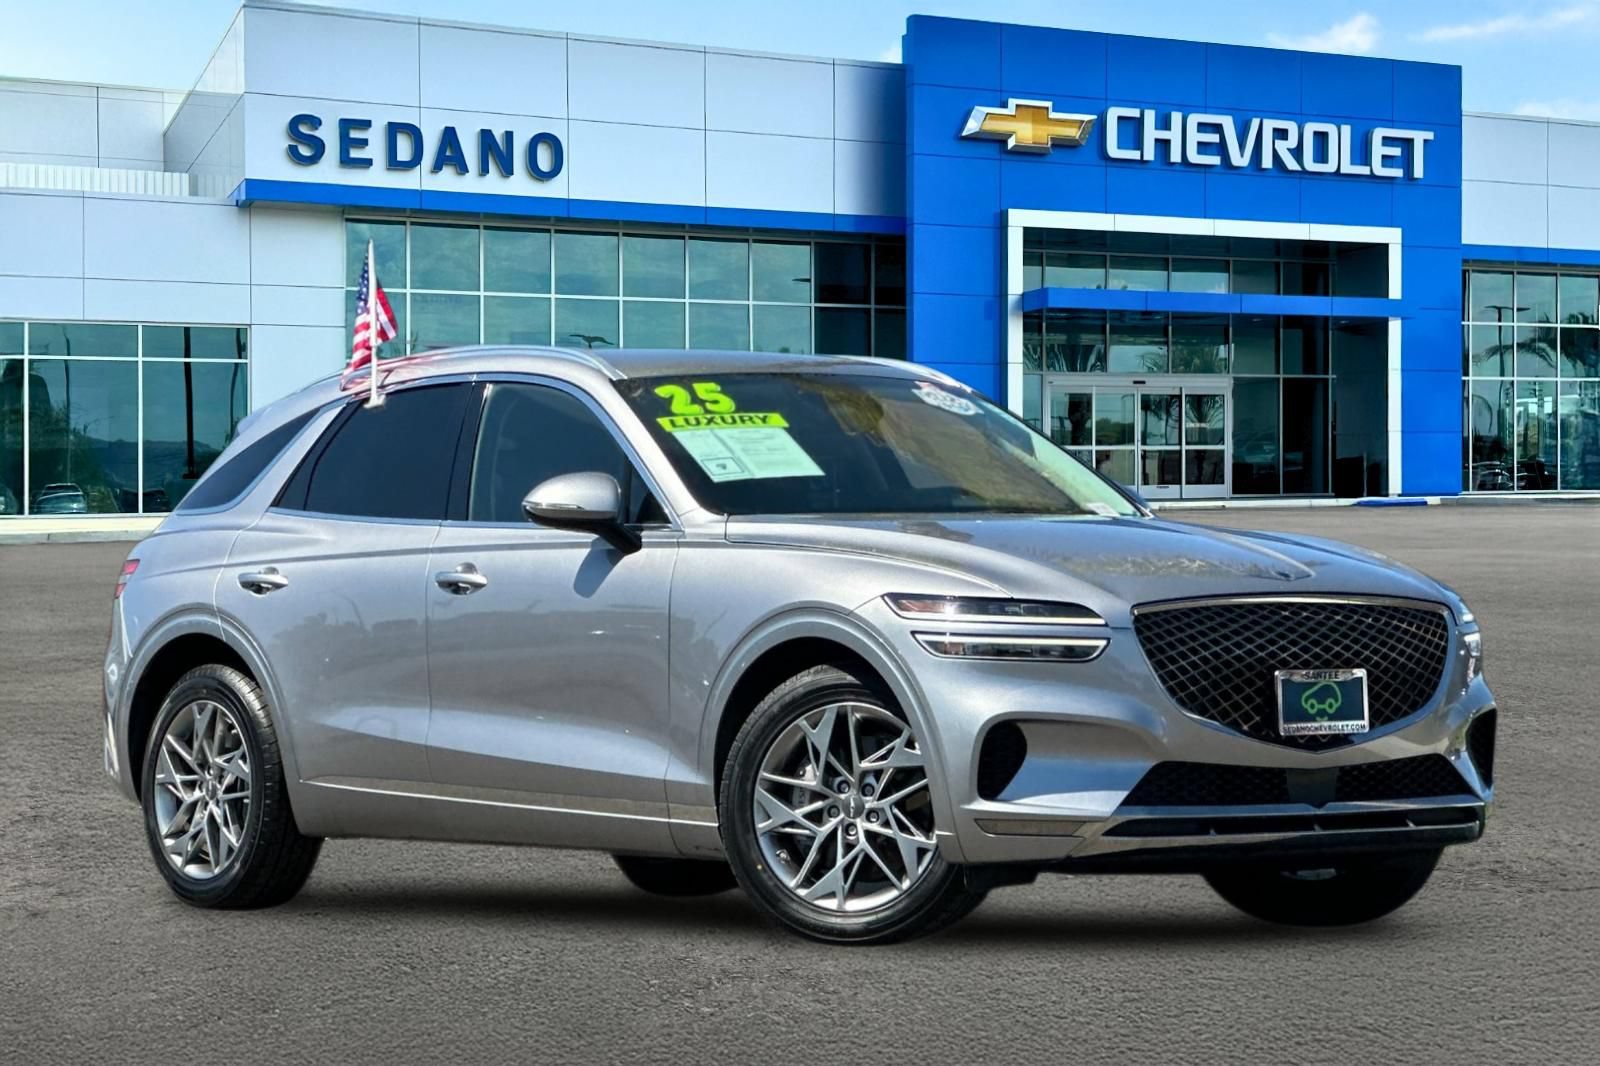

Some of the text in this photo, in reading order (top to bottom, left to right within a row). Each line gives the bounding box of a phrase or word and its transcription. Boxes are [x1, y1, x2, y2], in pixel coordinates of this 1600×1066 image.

[287, 113, 564, 182] SEDANO
[1105, 106, 1434, 179] CHEVROLET
[654, 382, 736, 415] 25
[669, 414, 770, 429] LUXURY
